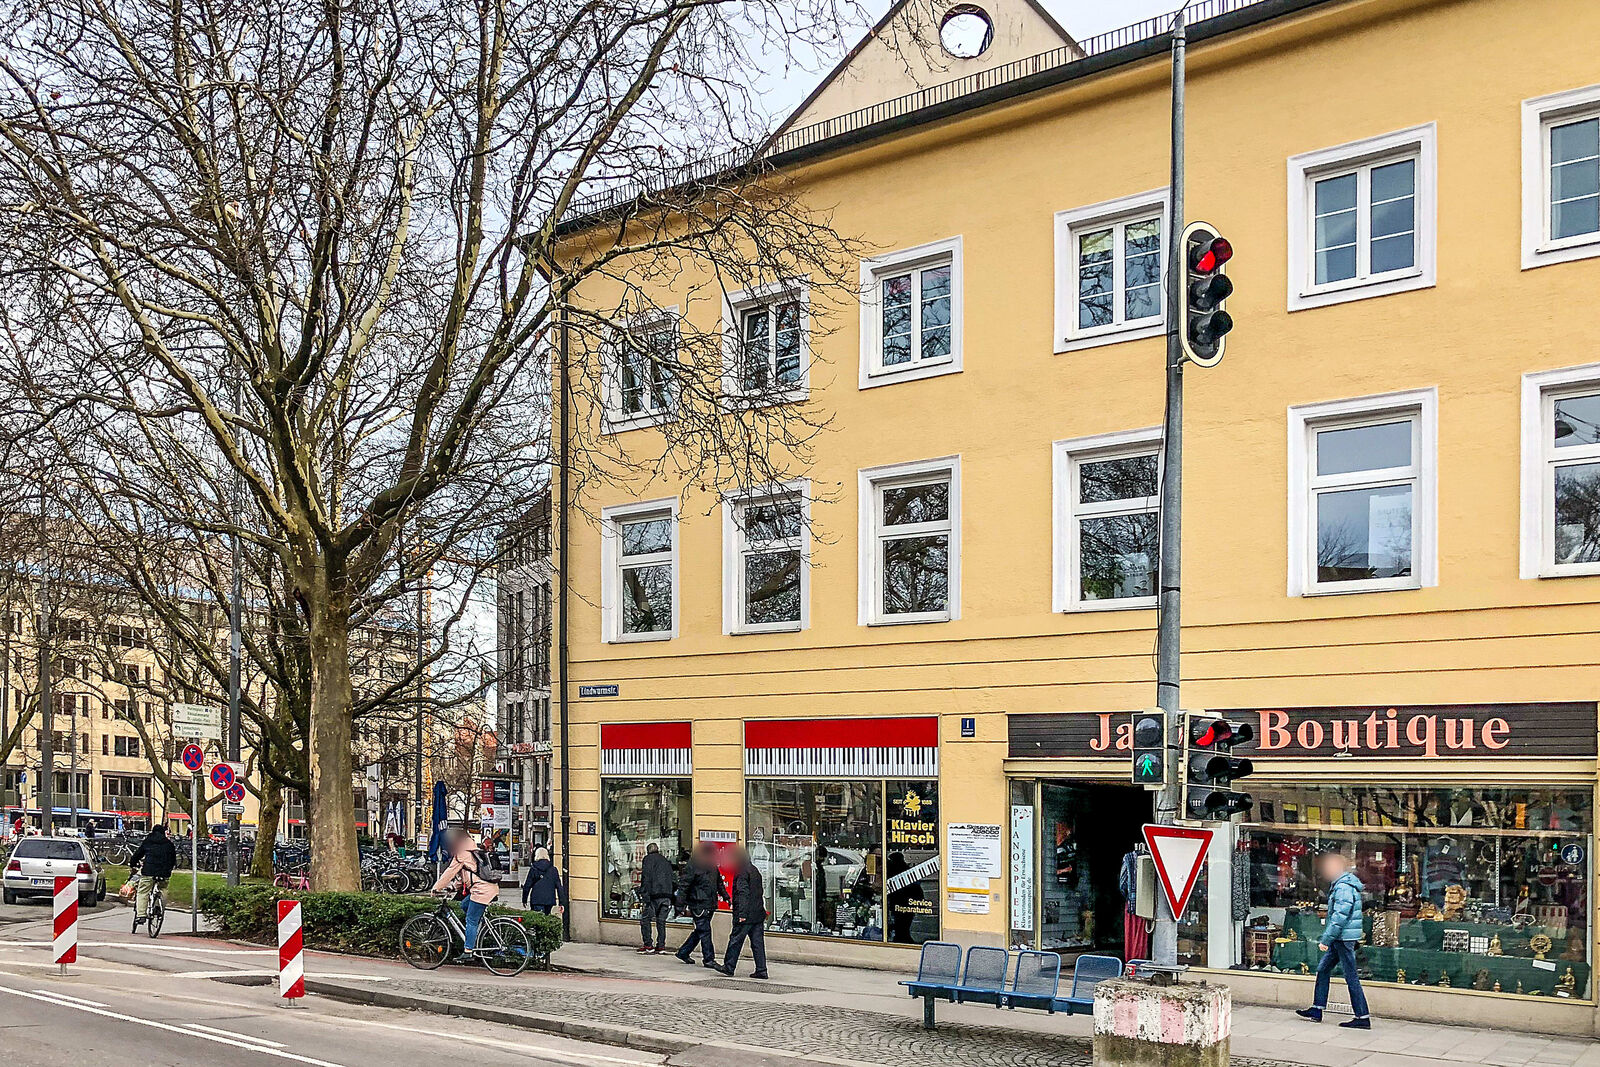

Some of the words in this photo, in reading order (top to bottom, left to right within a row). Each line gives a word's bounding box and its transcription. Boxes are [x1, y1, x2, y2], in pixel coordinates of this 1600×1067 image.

[581, 687, 617, 695] Lindwurmstr.
[1255, 708, 1511, 758] Boutique
[891, 819, 935, 831] Klavier
[891, 831, 935, 844] Hirsch
[908, 898, 933, 907] Service
[894, 905, 933, 914] Reparaturen
